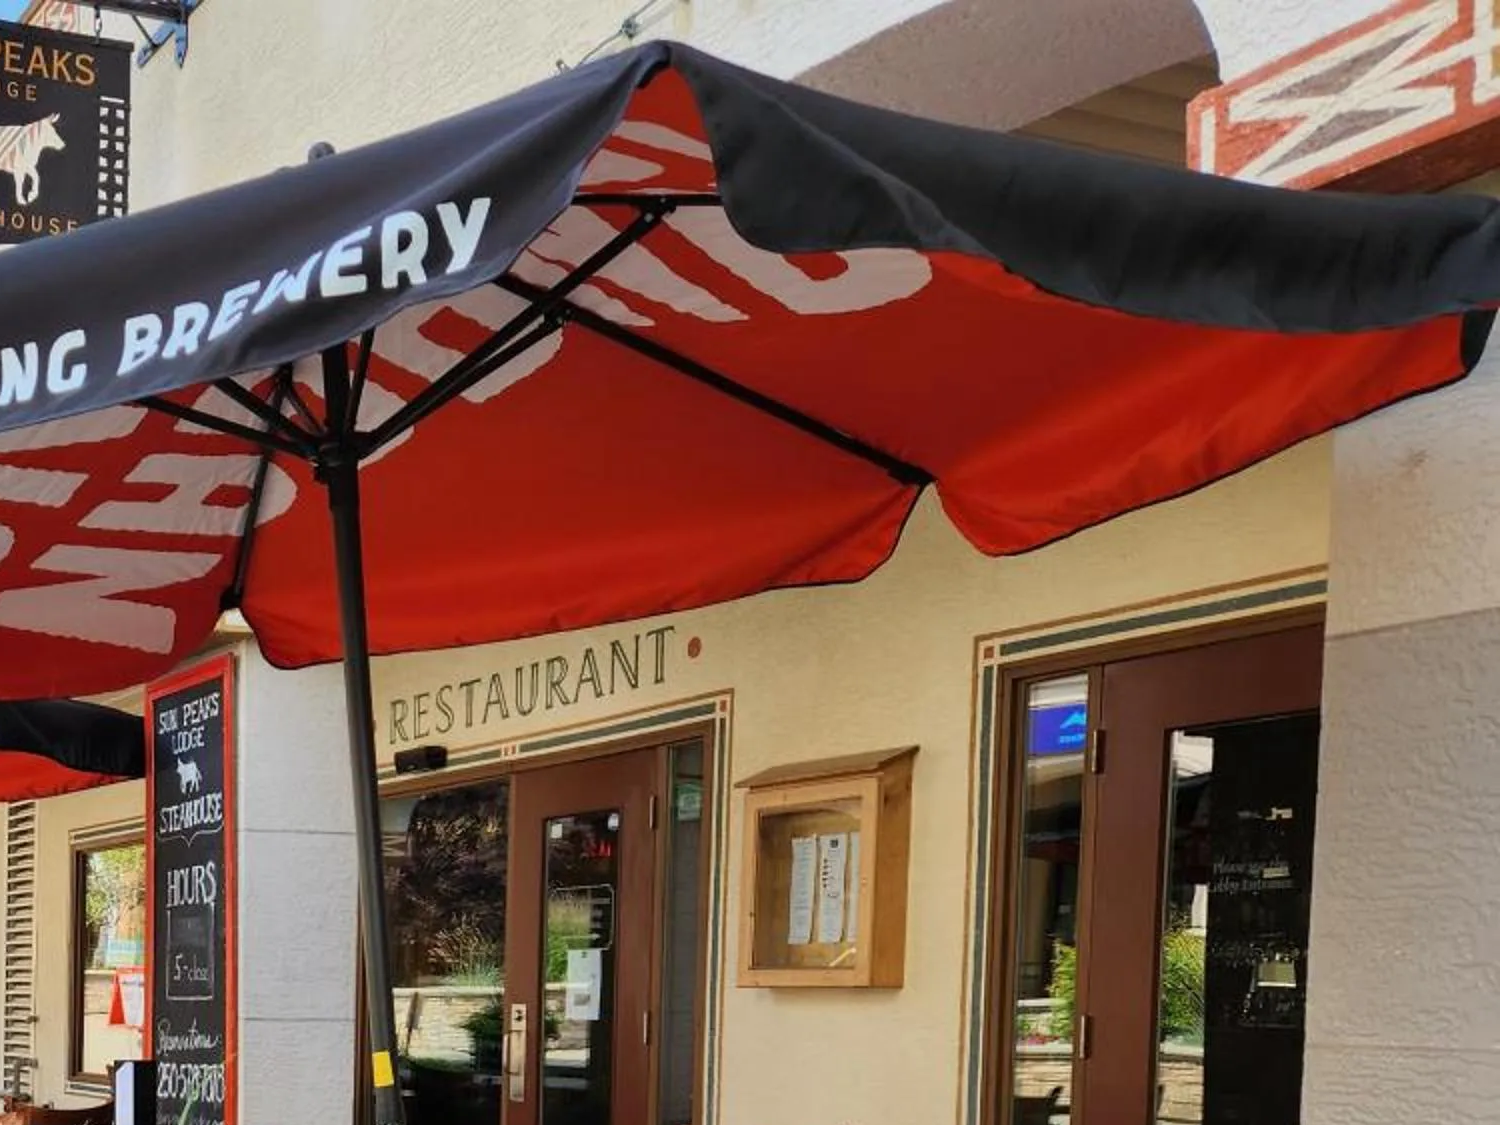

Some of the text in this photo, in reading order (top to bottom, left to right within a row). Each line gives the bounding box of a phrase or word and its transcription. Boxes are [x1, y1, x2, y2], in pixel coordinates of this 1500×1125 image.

[117, 197, 491, 378] BREWERY
[389, 625, 676, 745] RESTAURANT
[159, 691, 220, 734] SUN PEAKS
[172, 725, 205, 754] LODGE
[159, 792, 223, 834] STEAKHOUSE
[166, 861, 217, 908] HOURS
